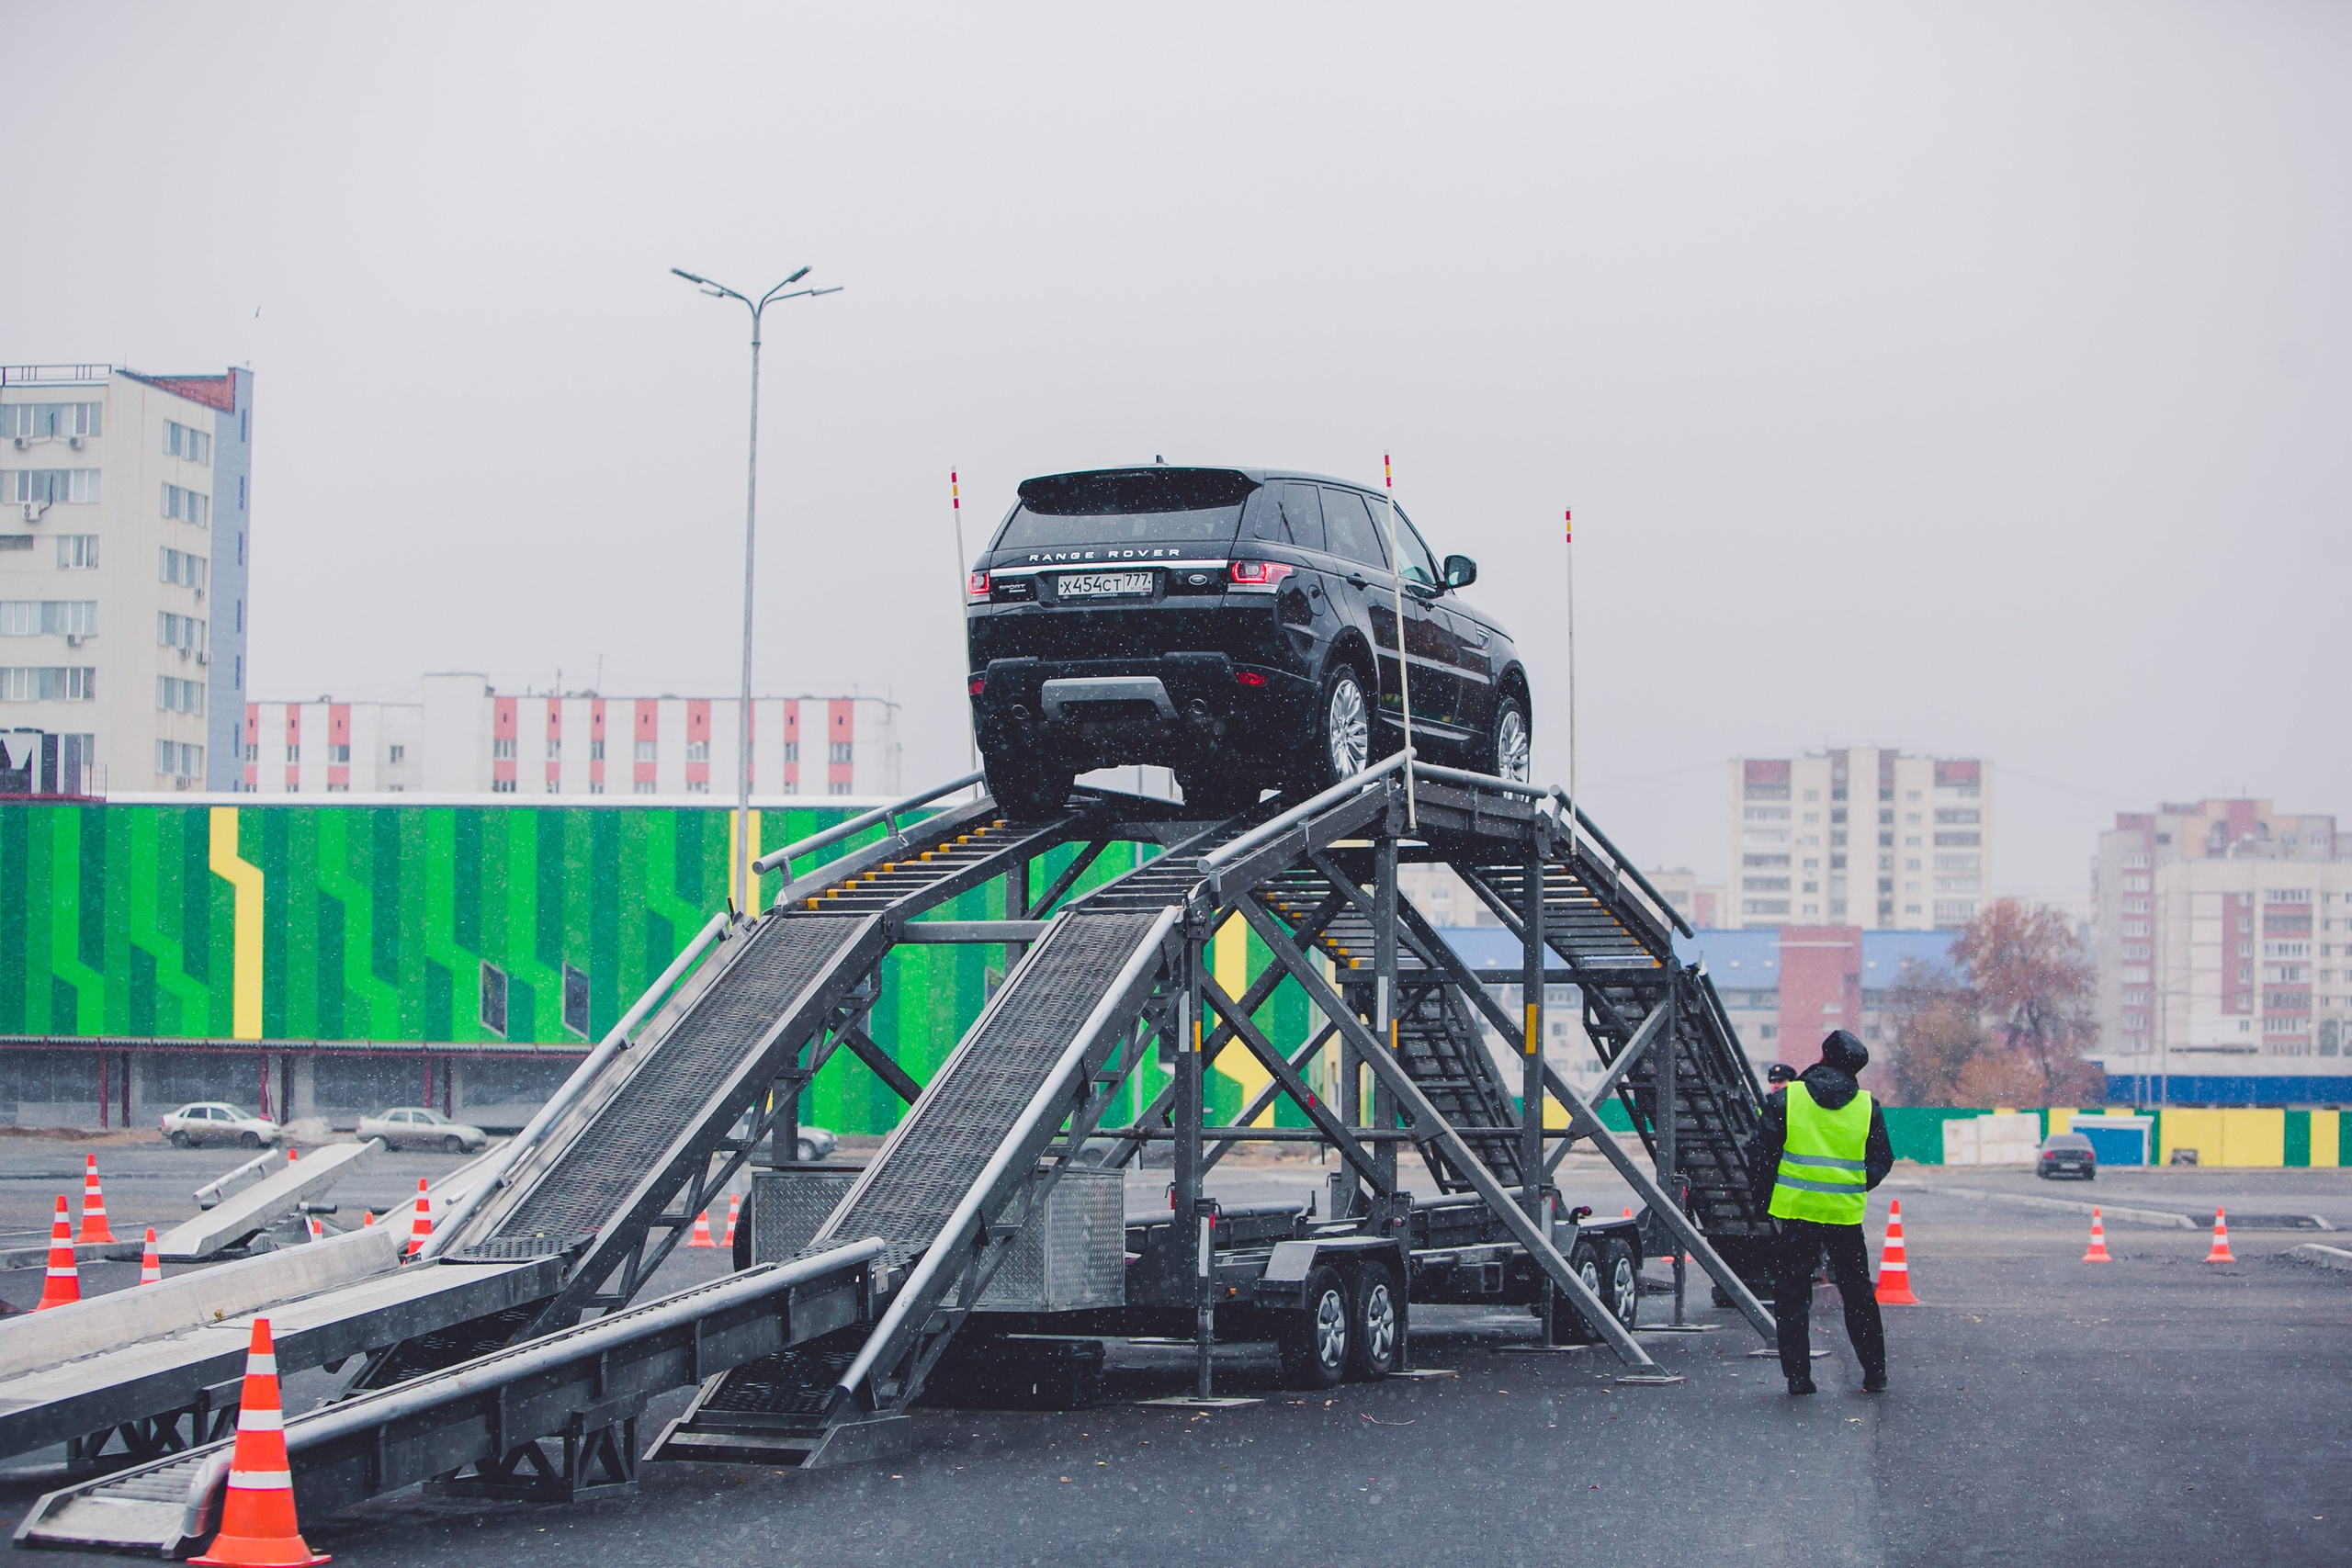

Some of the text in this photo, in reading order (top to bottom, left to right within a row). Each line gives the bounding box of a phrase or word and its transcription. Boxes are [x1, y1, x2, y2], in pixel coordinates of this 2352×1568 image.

[1029, 548, 1180, 562] RANGE ROVER
[1125, 573, 1149, 586] 777
